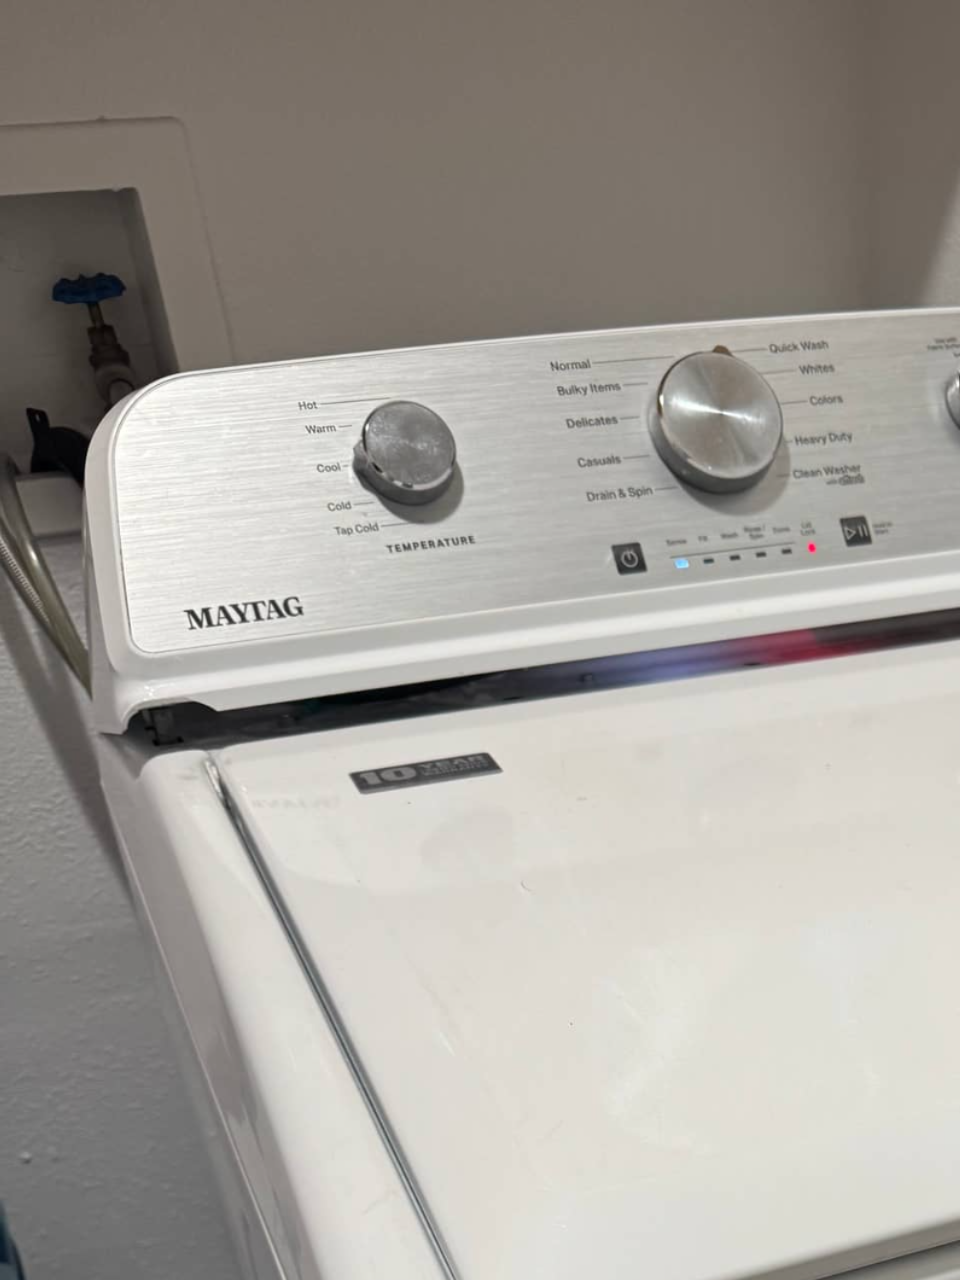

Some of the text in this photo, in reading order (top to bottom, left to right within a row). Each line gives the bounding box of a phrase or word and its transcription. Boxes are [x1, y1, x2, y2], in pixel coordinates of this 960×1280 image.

[769, 339, 829, 354] Quick Wash
[550, 359, 591, 372] Normal
[799, 362, 835, 375] Whites
[557, 381, 621, 397] Bulky Items
[298, 400, 318, 411] Hot
[809, 393, 843, 406] Colors
[305, 423, 336, 435] Warm
[566, 415, 618, 429] Delicates
[794, 431, 853, 447] Heavy Duty
[577, 454, 622, 468] Casuals
[316, 463, 341, 474] Cool
[793, 468, 823, 480] Clean
[824, 464, 861, 477] Washer
[586, 485, 653, 502] Drain & Spin
[327, 501, 352, 512] Cold
[335, 522, 379, 537] Tap Cold
[386, 535, 476, 554] TEMPERATURE
[184, 596, 304, 630] MAYTAG
[359, 766, 417, 785] 10
